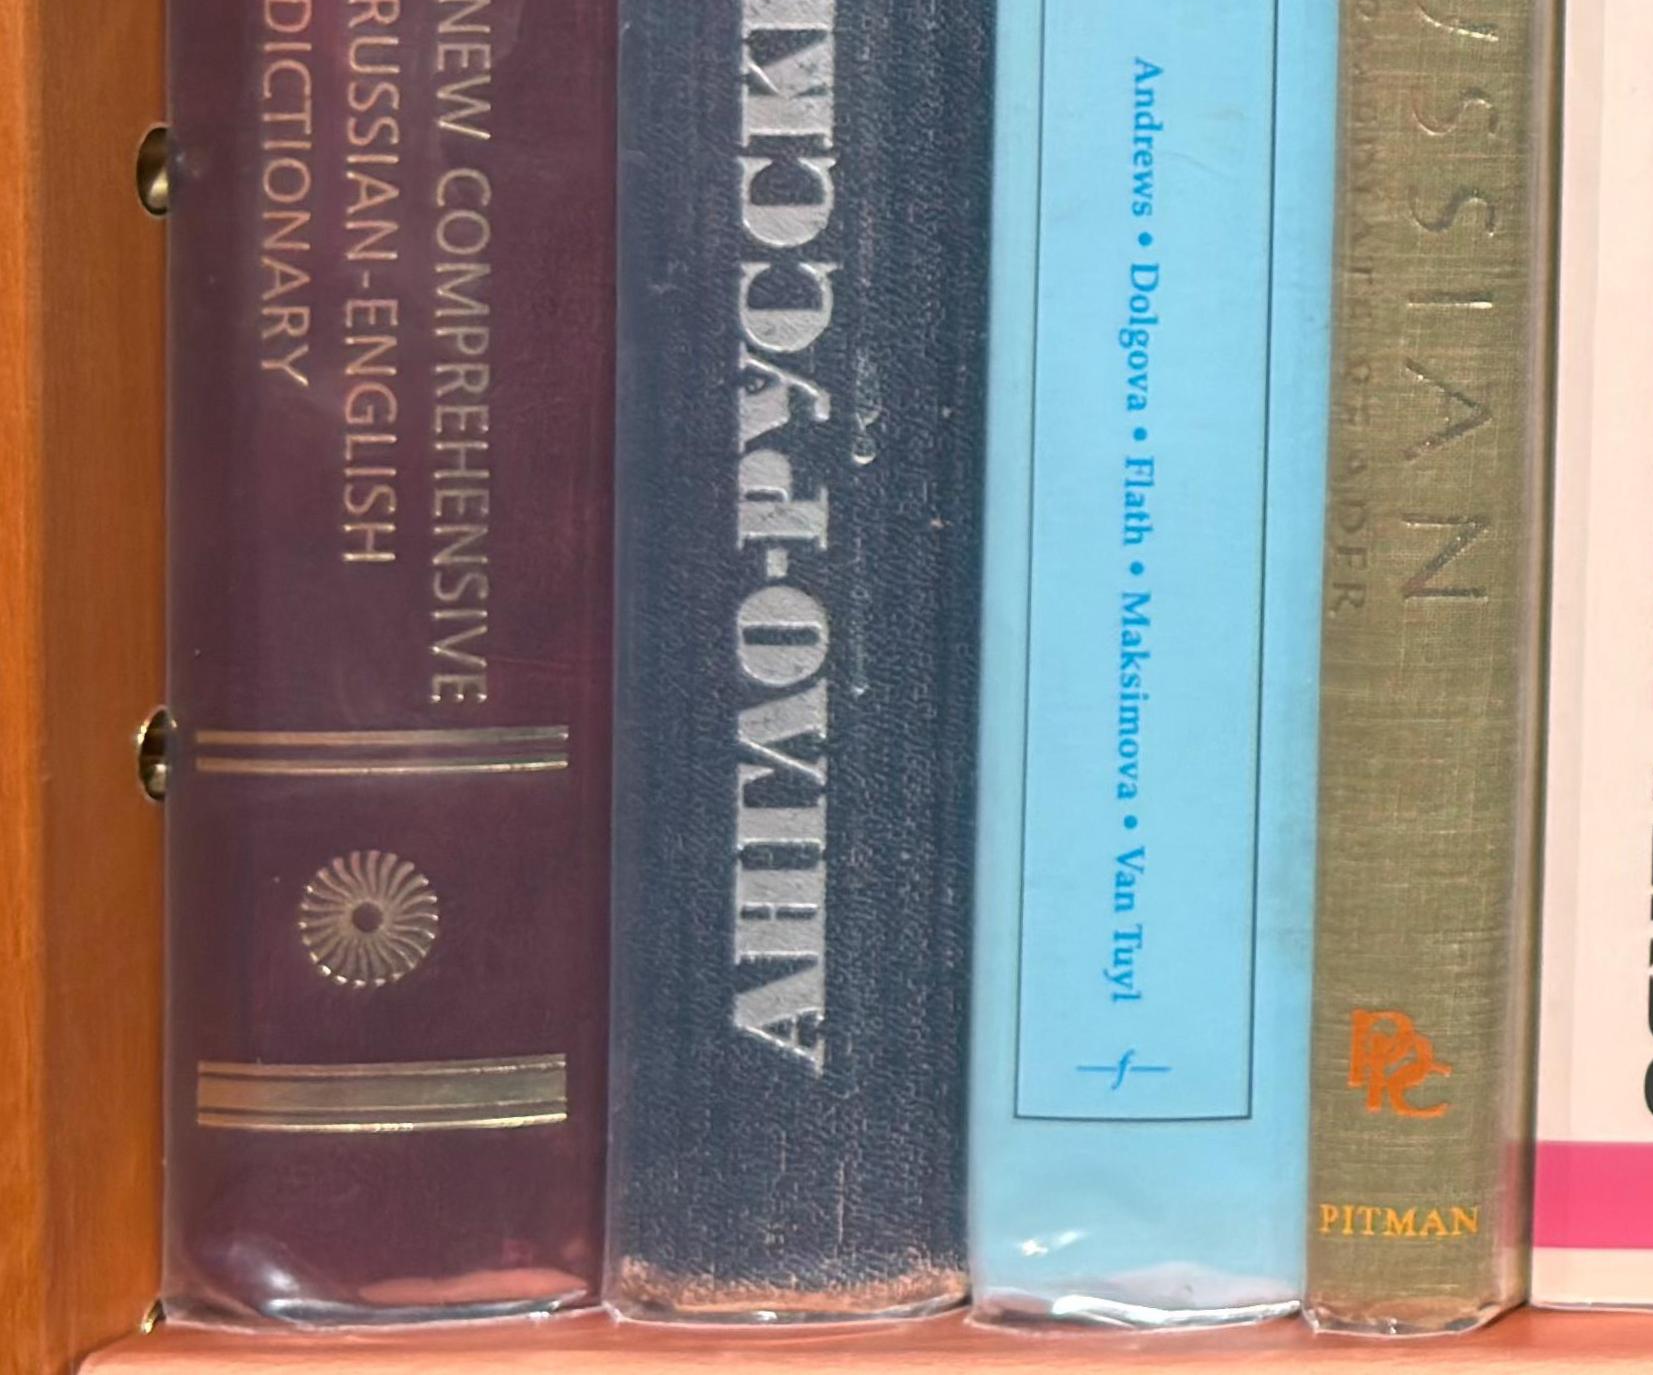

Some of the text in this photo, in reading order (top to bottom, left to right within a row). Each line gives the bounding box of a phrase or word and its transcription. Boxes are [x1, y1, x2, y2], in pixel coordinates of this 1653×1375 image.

[433, 167, 493, 707] COMPREHENSIVE
[1109, 56, 1162, 1006] Andrews Dolgova Flath Maksimova Van Tuyl
[1319, 1204, 1480, 1238] PITMAN
